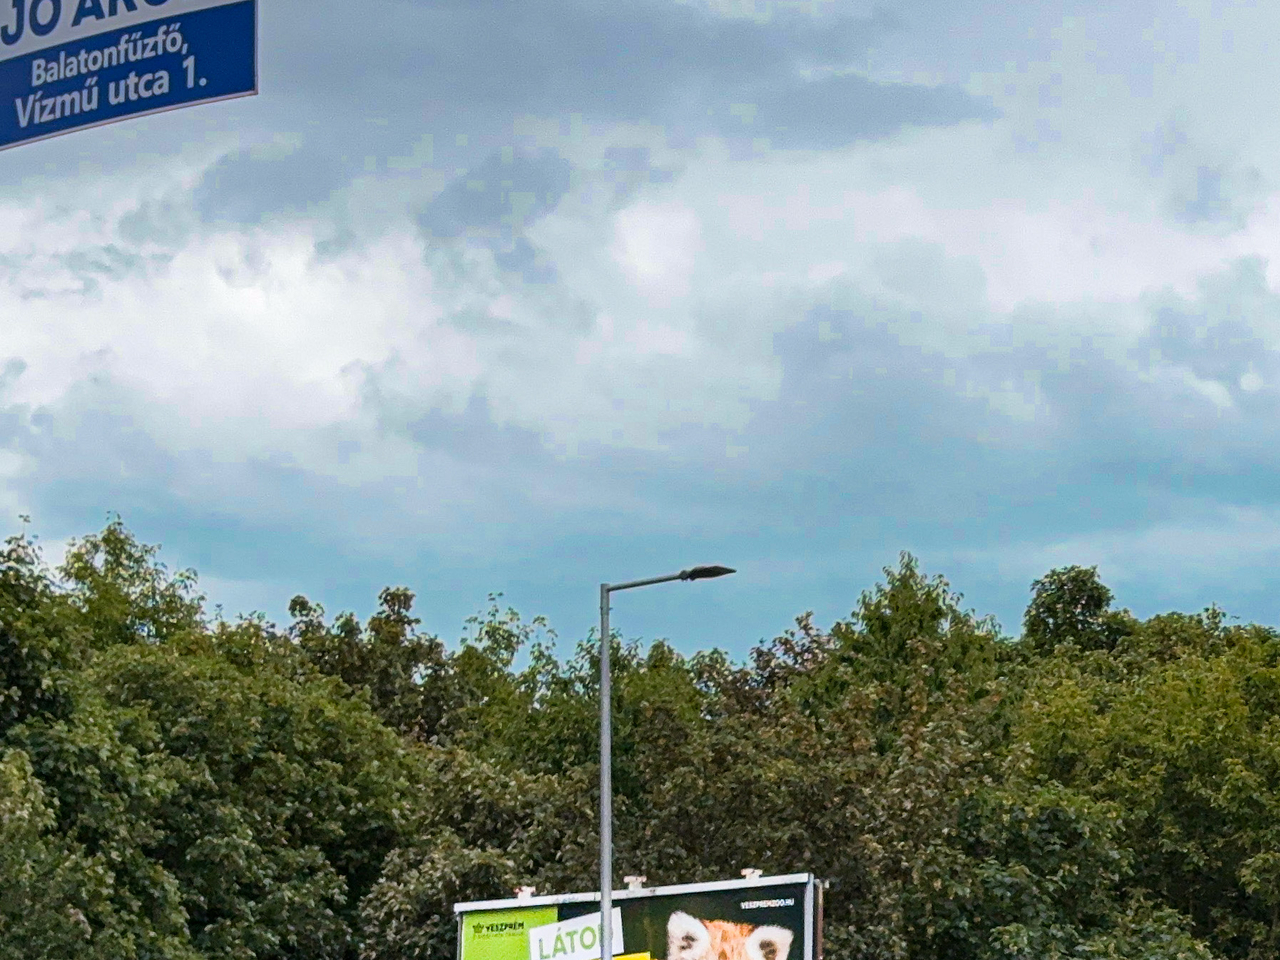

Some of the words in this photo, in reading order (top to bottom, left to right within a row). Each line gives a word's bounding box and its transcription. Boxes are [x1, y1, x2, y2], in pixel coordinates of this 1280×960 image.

[31, 22, 188, 87] Balatonfűzfő,
[15, 77, 99, 128] Vízmű
[108, 70, 170, 105] utca
[182, 55, 207, 89] 1.
